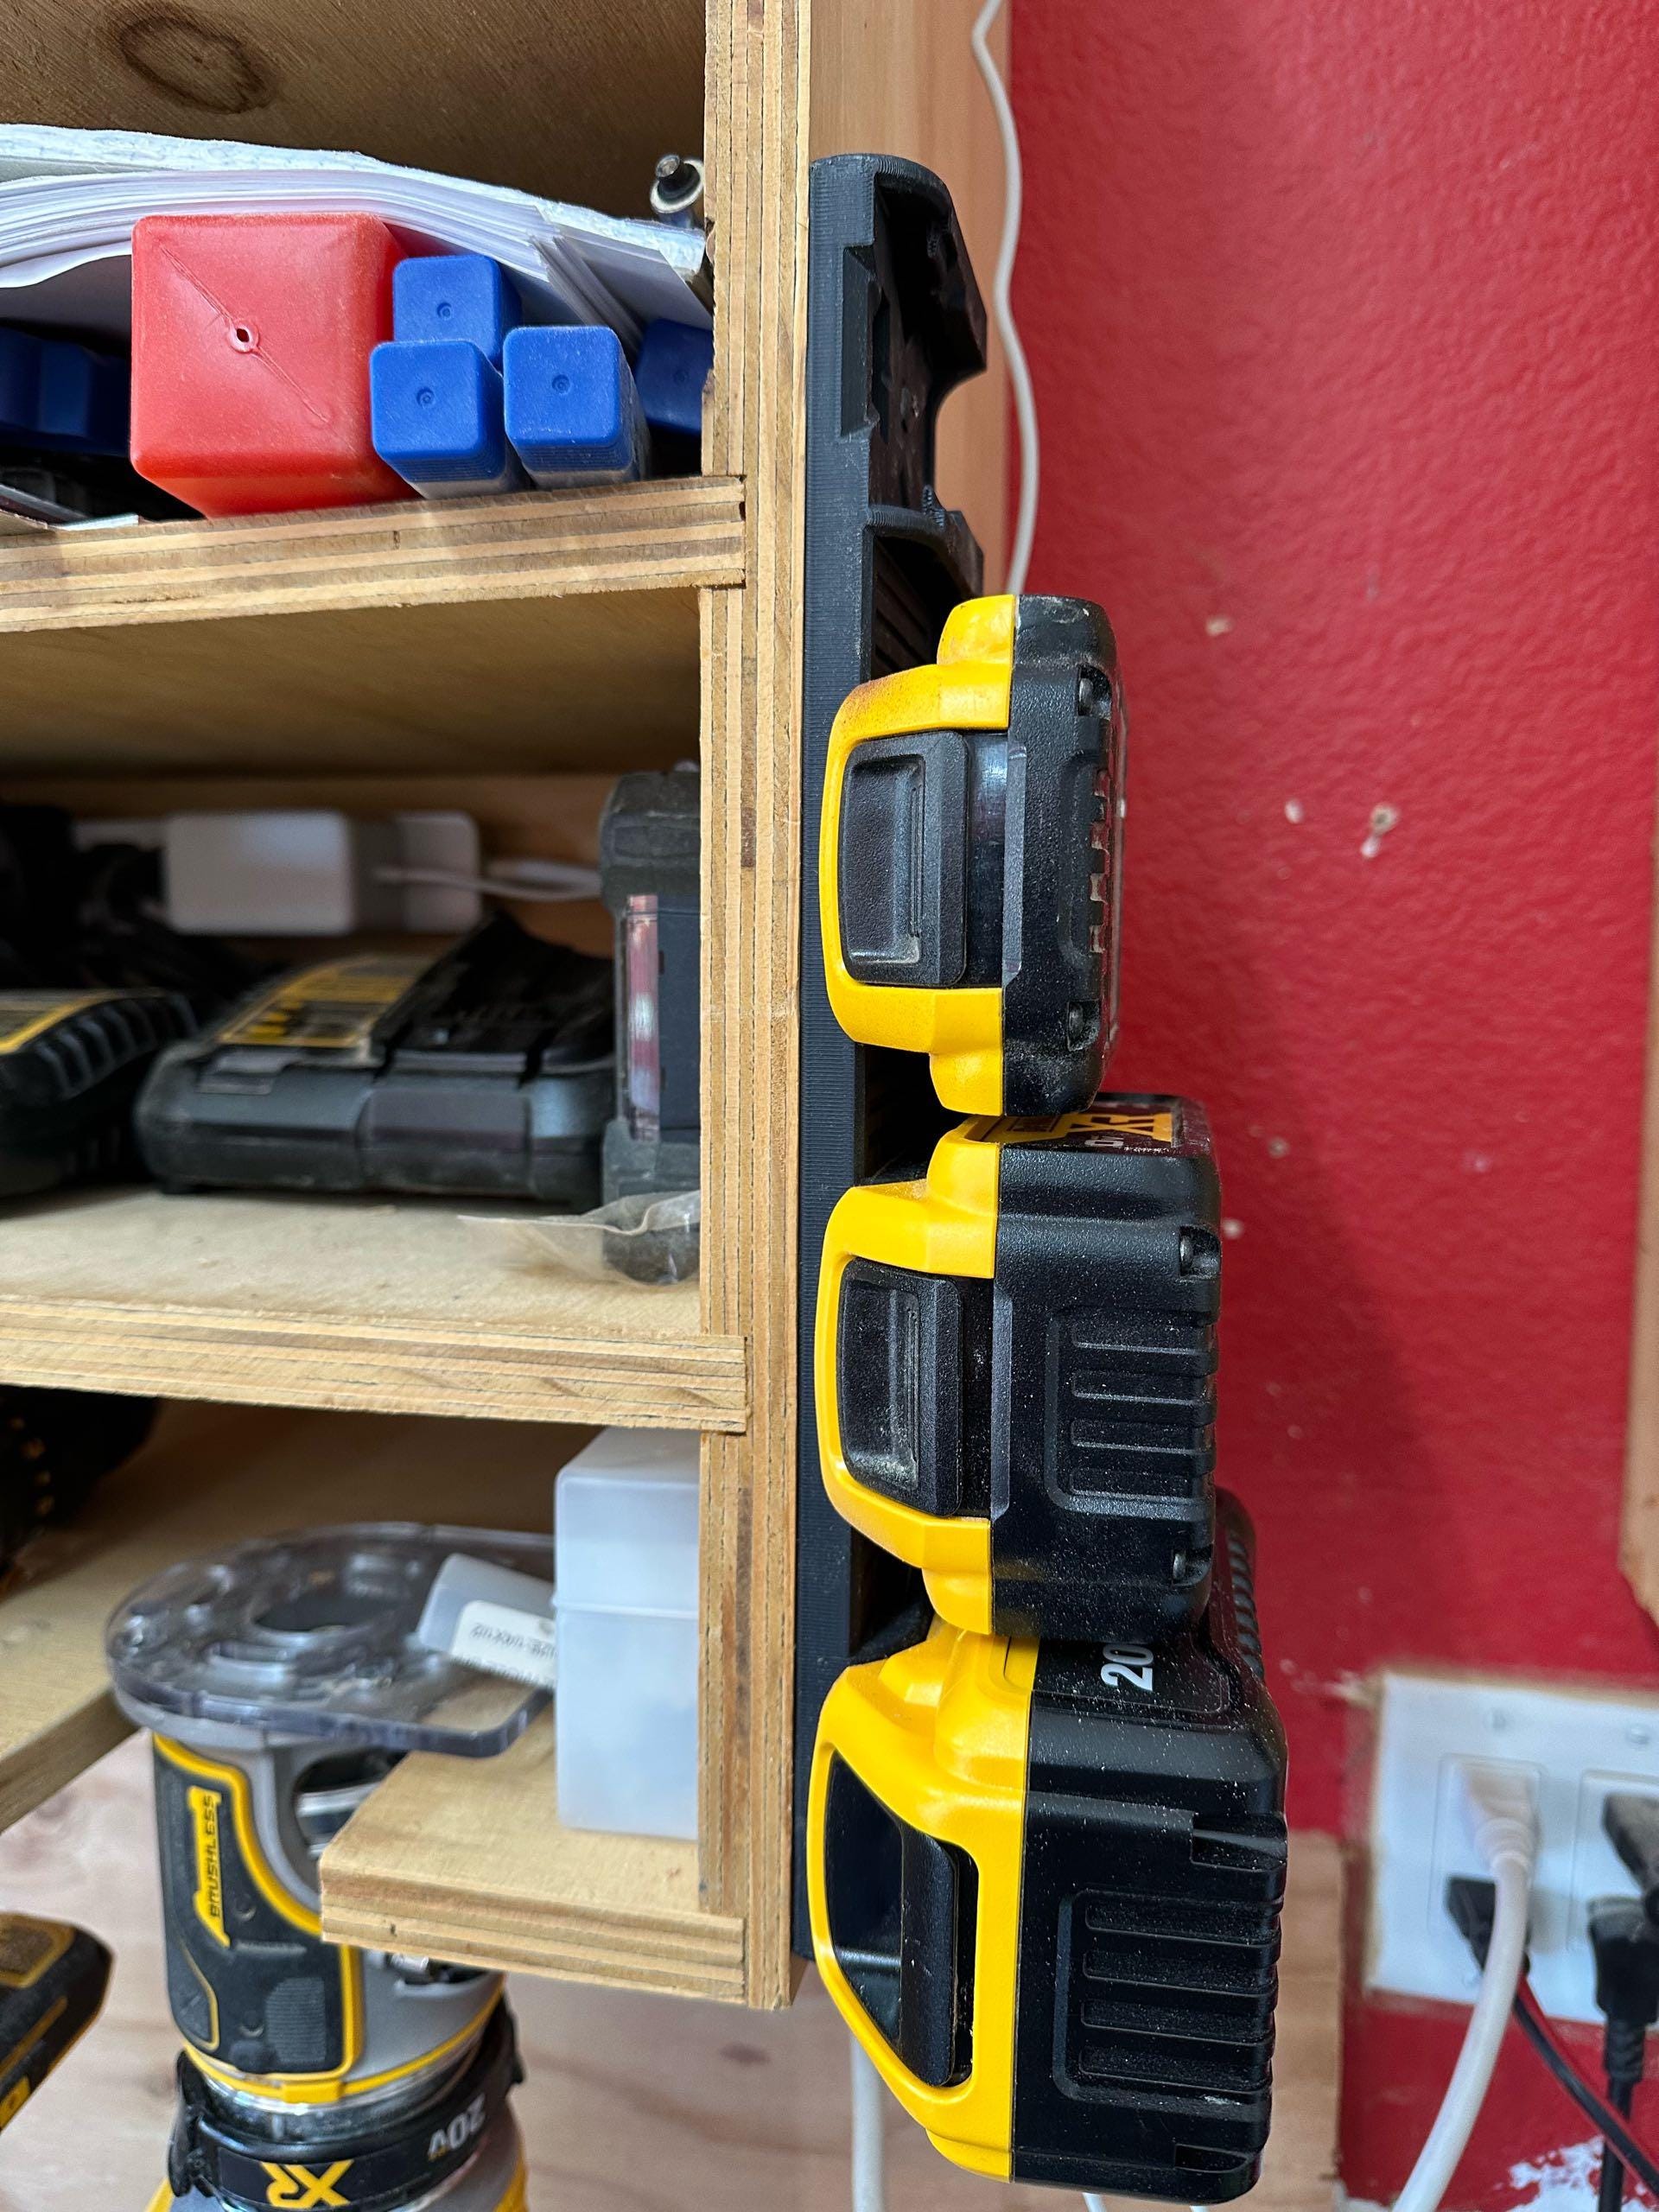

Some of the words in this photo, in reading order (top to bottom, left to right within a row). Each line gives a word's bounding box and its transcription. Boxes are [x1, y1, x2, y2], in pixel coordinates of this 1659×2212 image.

[203, 1795, 220, 1918] BRUSHLESS
[429, 2093, 486, 2160] 20V
[261, 2159, 353, 2209] XR
